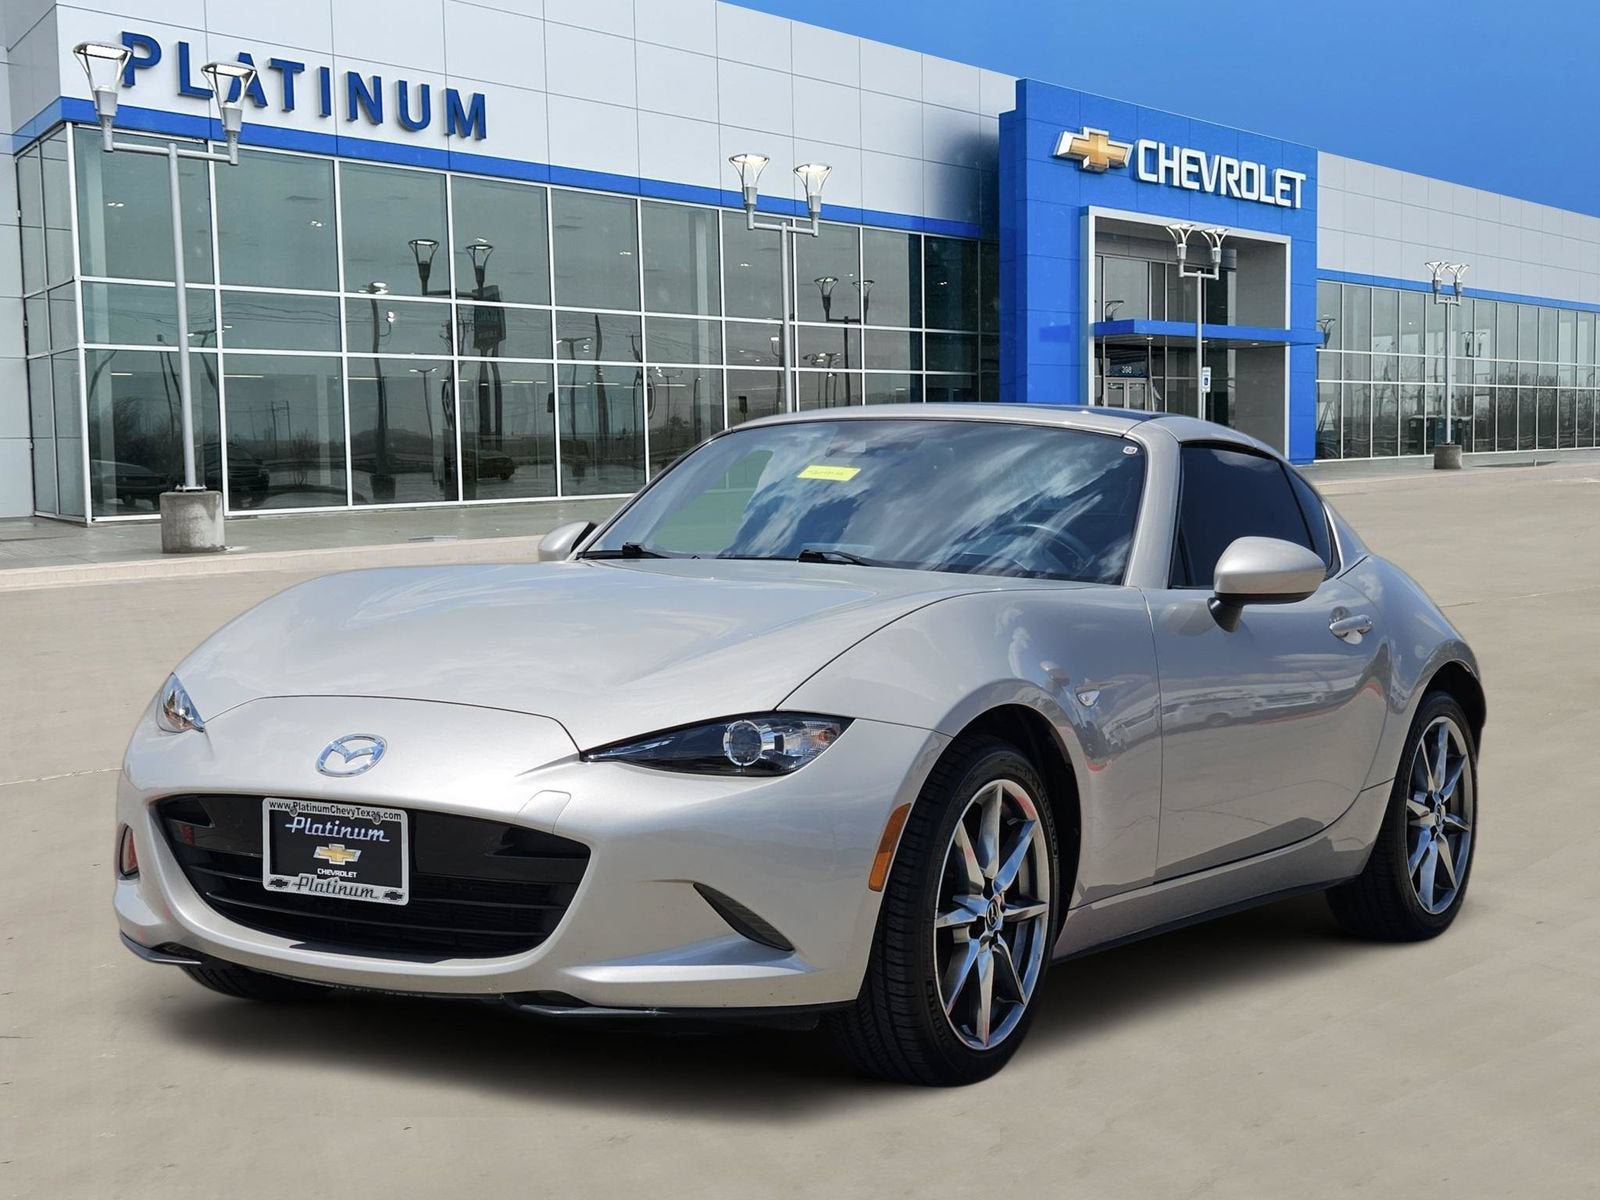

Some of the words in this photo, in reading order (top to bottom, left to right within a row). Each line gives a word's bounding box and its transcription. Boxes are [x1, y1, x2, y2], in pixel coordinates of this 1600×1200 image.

[121, 31, 487, 140] PLATINUM
[1137, 139, 1306, 208] CHEVROLET
[285, 817, 390, 842] Platinum
[317, 868, 357, 878] CHEVROLET
[291, 876, 380, 899] Platinum
